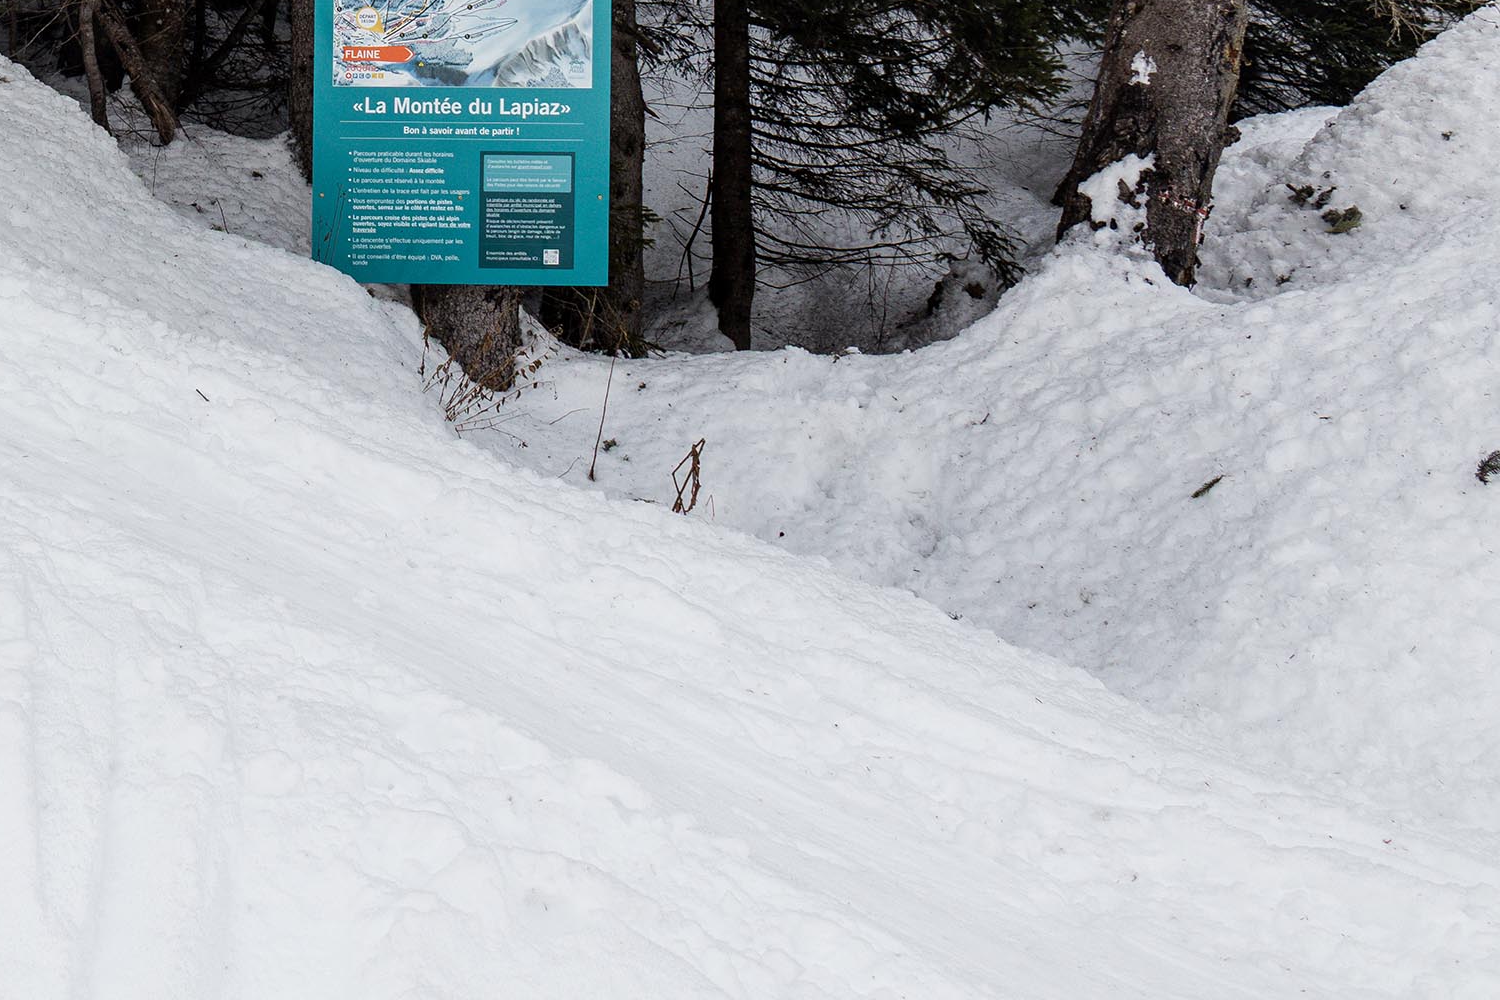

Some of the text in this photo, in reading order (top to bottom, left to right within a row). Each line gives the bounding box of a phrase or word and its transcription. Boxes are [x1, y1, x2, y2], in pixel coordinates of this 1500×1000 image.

[345, 50, 380, 59] FLAINE
[353, 97, 571, 119] «La Montée du Lapiaz»
[403, 126, 419, 135] Bon
[422, 126, 427, 135] à
[429, 126, 453, 135] savoir
[455, 127, 477, 135] avant
[480, 127, 489, 135] de
[492, 127, 514, 137] partir
